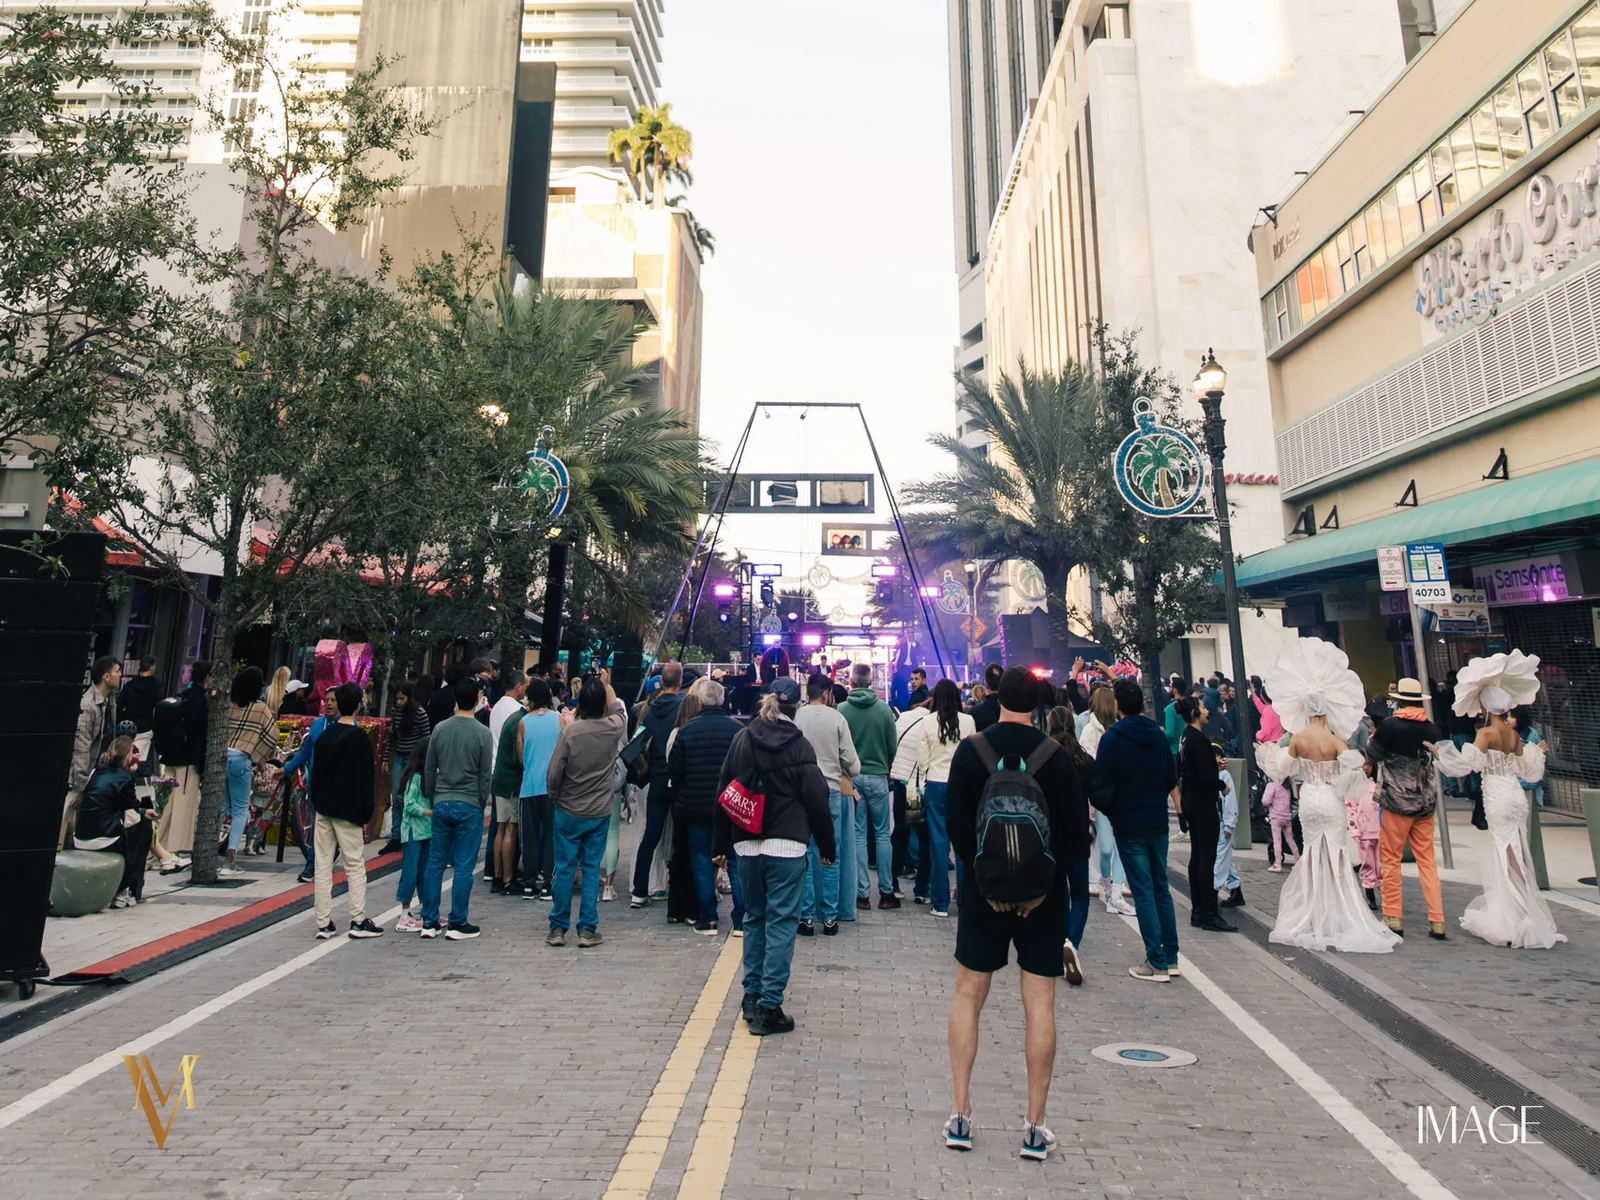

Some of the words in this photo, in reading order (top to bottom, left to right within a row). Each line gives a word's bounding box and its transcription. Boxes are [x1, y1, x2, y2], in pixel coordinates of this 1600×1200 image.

[1416, 208, 1523, 317] Alberto
[1525, 138, 1600, 245] Cor
[1495, 563, 1565, 589] Samsonite
[1415, 588, 1446, 597] 40703
